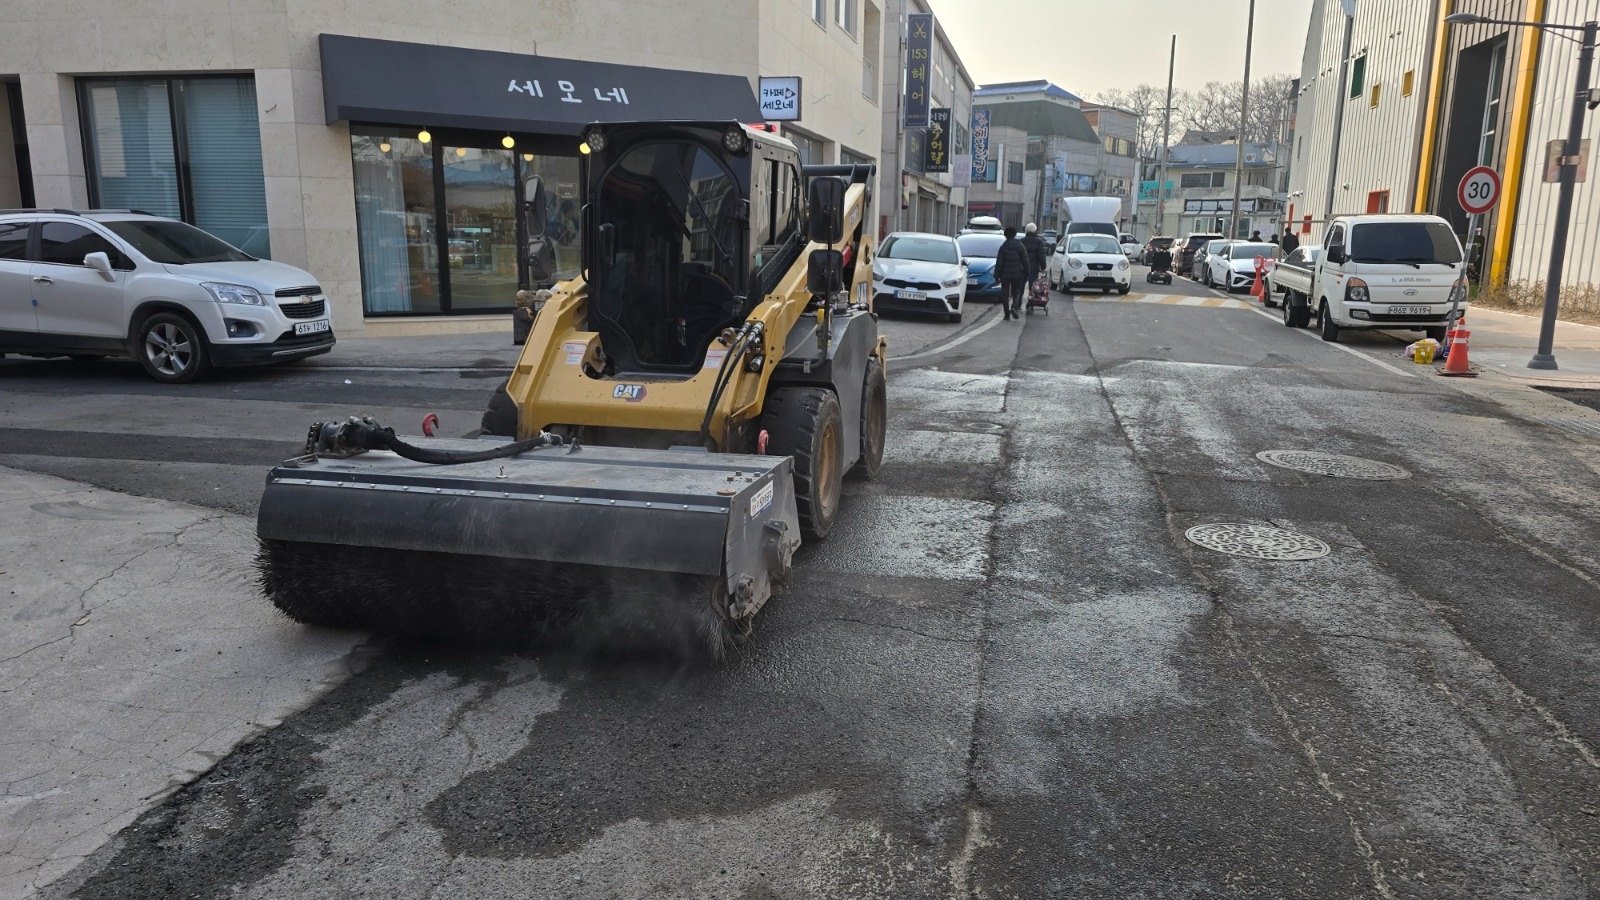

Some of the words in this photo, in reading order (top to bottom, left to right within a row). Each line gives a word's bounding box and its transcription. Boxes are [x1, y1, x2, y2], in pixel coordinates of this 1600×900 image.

[911, 48, 928, 60] 153
[911, 63, 925, 106] 헤어
[762, 88, 784, 98] 카페
[1468, 181, 1490, 199] 30
[313, 321, 327, 331] 1216
[613, 384, 642, 399] CAT
